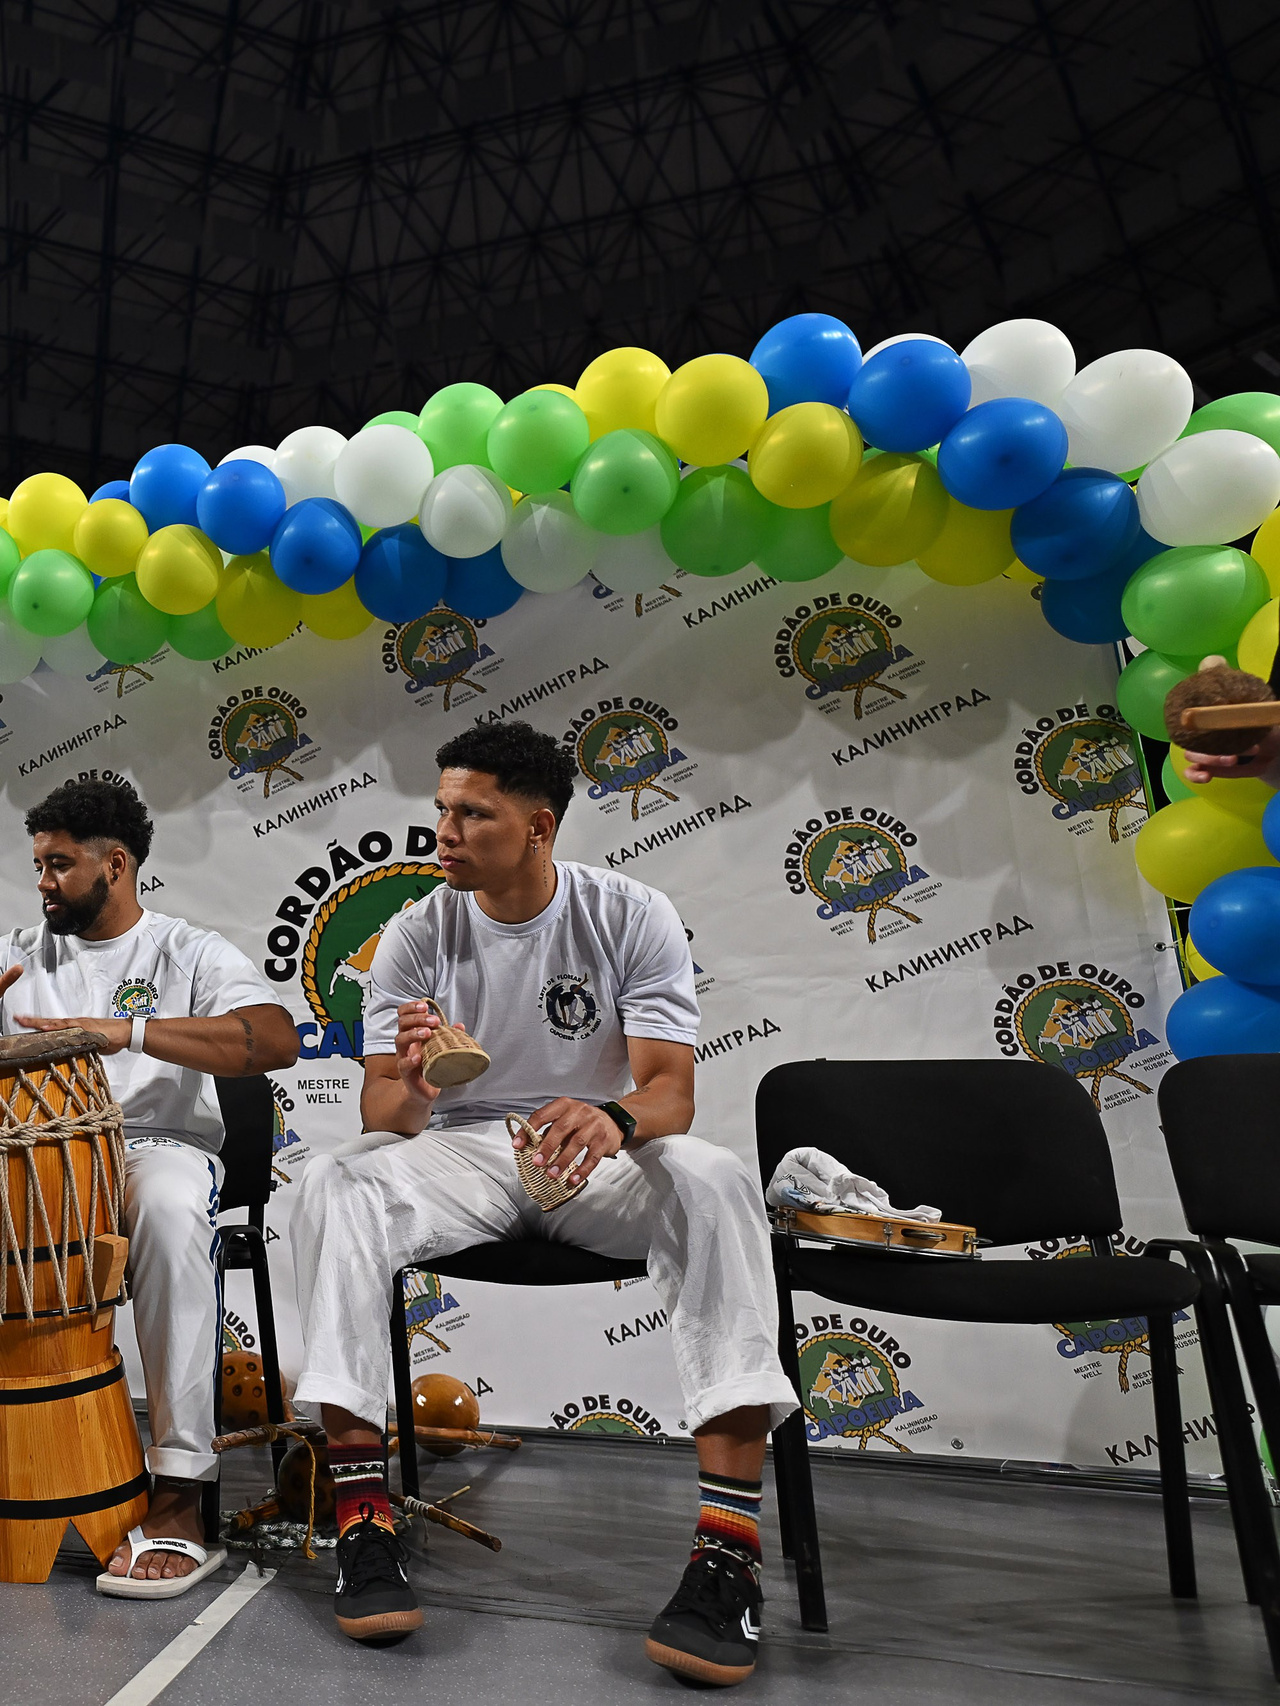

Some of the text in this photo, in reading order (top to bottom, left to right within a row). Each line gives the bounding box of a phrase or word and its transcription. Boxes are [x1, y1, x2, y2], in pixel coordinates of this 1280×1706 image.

[682, 575, 778, 628] КАЛИНИН
[774, 592, 902, 678] CORDÃO DE OURO
[18, 714, 127, 777] КАЛИНИНГРАД
[209, 686, 307, 760] CORDÃO DE OURO
[562, 697, 678, 757] RDÃO DE OURO
[831, 688, 991, 766] КАЛИНИНГРАД
[1014, 703, 1090, 795] CORDÃO DE
[78, 769, 98, 783] DE
[588, 747, 688, 800] CAPOEIRA
[253, 772, 377, 838] КАЛИНИНГРАД
[1067, 818, 1094, 834] MESTRE
[605, 795, 752, 868] КАЛИНИНГРАД
[784, 806, 917, 895] CORDÃO DE OURO
[1075, 826, 1095, 837] WELL
[264, 825, 437, 983] CORDÃO D
[816, 864, 930, 920] CAPOEIRA
[902, 881, 942, 903] KALININGRAD
[830, 919, 854, 932] MESTRE
[836, 927, 854, 936] WELL
[878, 923, 911, 940] SUASSUNA
[879, 919, 903, 932] MESTRE
[865, 915, 1034, 993] КАЛИНИНГРАД
[546, 977, 556, 987] DE
[994, 961, 1145, 1057] CORDÃO DE OURO
[694, 1018, 781, 1064] ИНГРАД
[1058, 1028, 1161, 1076] POEIRA
[297, 1079, 350, 1090] MESTRE
[306, 1093, 342, 1104] WELL
[1103, 1093, 1140, 1110] SUASSUNA
[1104, 1088, 1132, 1103] MESTRE
[225, 1311, 256, 1349] URO
[811, 1314, 843, 1332] DE
[849, 1317, 912, 1369] OURO
[1073, 1360, 1102, 1375] MESTRE
[1081, 1369, 1102, 1380] WELL
[582, 1394, 662, 1437] DE OUR
[805, 1390, 925, 1442] CAPOEIRA
[894, 1413, 938, 1432] KALININGRAD
